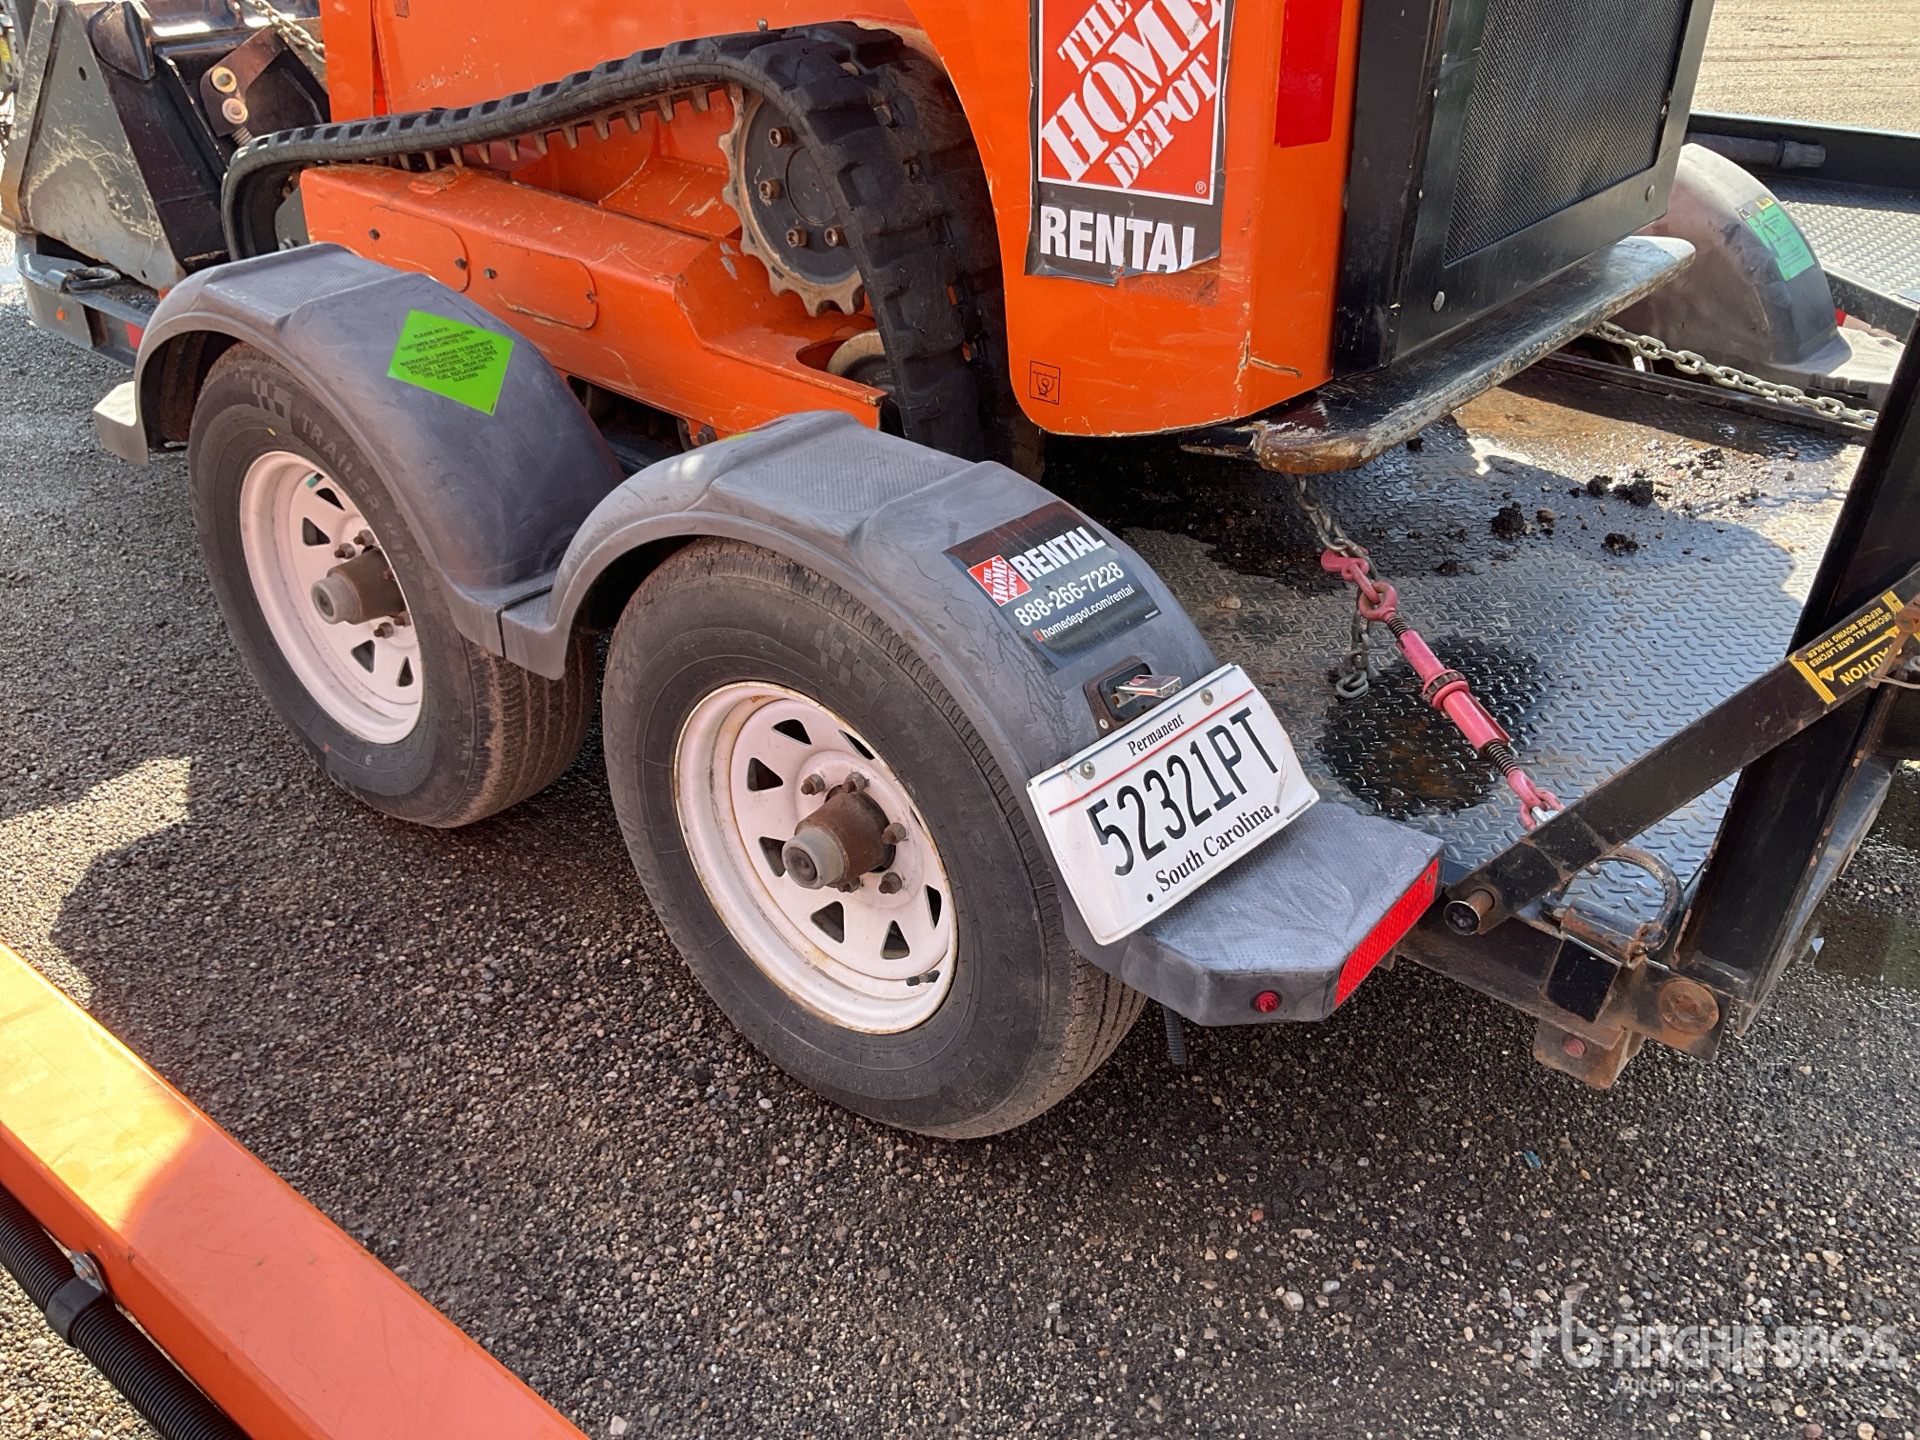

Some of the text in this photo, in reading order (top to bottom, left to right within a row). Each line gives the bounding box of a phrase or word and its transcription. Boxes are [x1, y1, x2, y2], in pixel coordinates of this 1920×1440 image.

[1056, 0, 1134, 75] THE
[1040, 0, 1222, 183] HOME
[1103, 51, 1217, 190] DEPOT
[300, 412, 382, 512] TRAILER
[983, 567, 993, 585] THE
[992, 557, 1009, 602] HOME
[1008, 526, 1106, 582] RENTAL
[1008, 569, 1018, 597] DEPOT
[1013, 560, 1125, 626] 888-266-7228
[1040, 583, 1135, 639] homedepot.com/rental
[1807, 607, 1884, 659] BEFORE MOVING TRAILER
[1809, 612, 1893, 668] SECURE ALL GATE LATCHES
[1127, 712, 1185, 756] Permanent
[1086, 706, 1279, 877] 52321PT
[1155, 850, 1206, 893] South
[1203, 801, 1275, 859] Carolina
